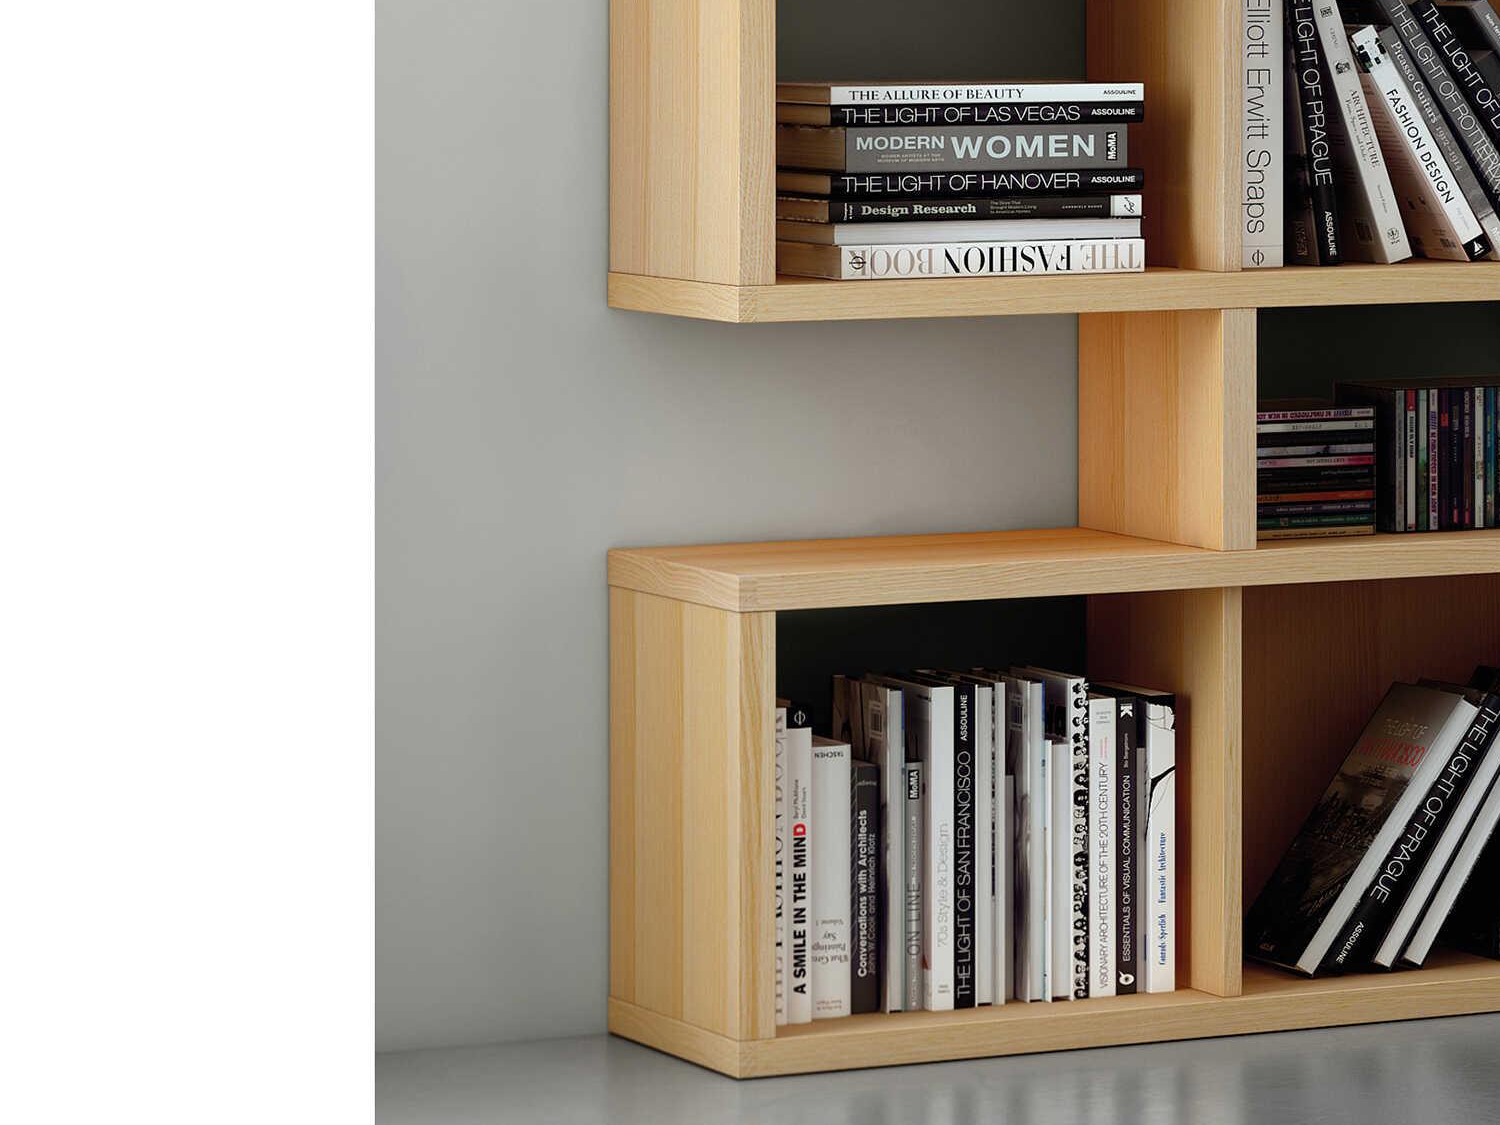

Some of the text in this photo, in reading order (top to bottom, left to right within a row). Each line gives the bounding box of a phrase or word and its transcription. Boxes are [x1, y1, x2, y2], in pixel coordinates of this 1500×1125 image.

[1296, 7, 1318, 65] LIGHT
[1391, 0, 1418, 37] THE
[1409, 33, 1447, 80] LIGHT
[1439, 81, 1461, 103] OF
[1423, 3, 1452, 43] THE
[1443, 38, 1484, 87] LIGHT
[1476, 88, 1500, 112] OF
[849, 88, 1025, 101] THE ALLURE OF BEAUTY
[1247, 69, 1271, 140] Erwitt
[1303, 69, 1322, 96] OF
[841, 105, 1081, 123] THE LIGHT OF LAS VEGAS
[1091, 108, 1135, 116] ASSOULINE
[856, 135, 944, 150] MODERN
[951, 134, 1095, 159] WOMEN
[1306, 100, 1333, 186] PRAGUE
[1386, 88, 1455, 204] FASHION DESIGN
[841, 173, 1080, 193] THE LIGHT OF HANOVER
[1091, 175, 1136, 183] ASSOULINE
[1242, 150, 1271, 234] Snaps
[861, 205, 909, 217] Design
[913, 203, 977, 215] Research
[1325, 211, 1337, 256] ASSOULINE
[943, 245, 1072, 274] FASHION
[1080, 244, 1141, 270] THE
[960, 695, 968, 741] ASSOULINE
[1099, 762, 1109, 810] CENTURY
[1370, 707, 1500, 904] THE LIGHT OF PRAGUE
[793, 823, 806, 867] MIND
[793, 873, 806, 903] THE
[858, 810, 867, 977] Conversations with Architects
[957, 751, 971, 999] THE LIGHT OF SAN FRANCISCO
[793, 908, 806, 924] IN
[793, 929, 806, 979] SMILE
[1336, 922, 1364, 964] ASSOULINE
[793, 984, 806, 994] A
